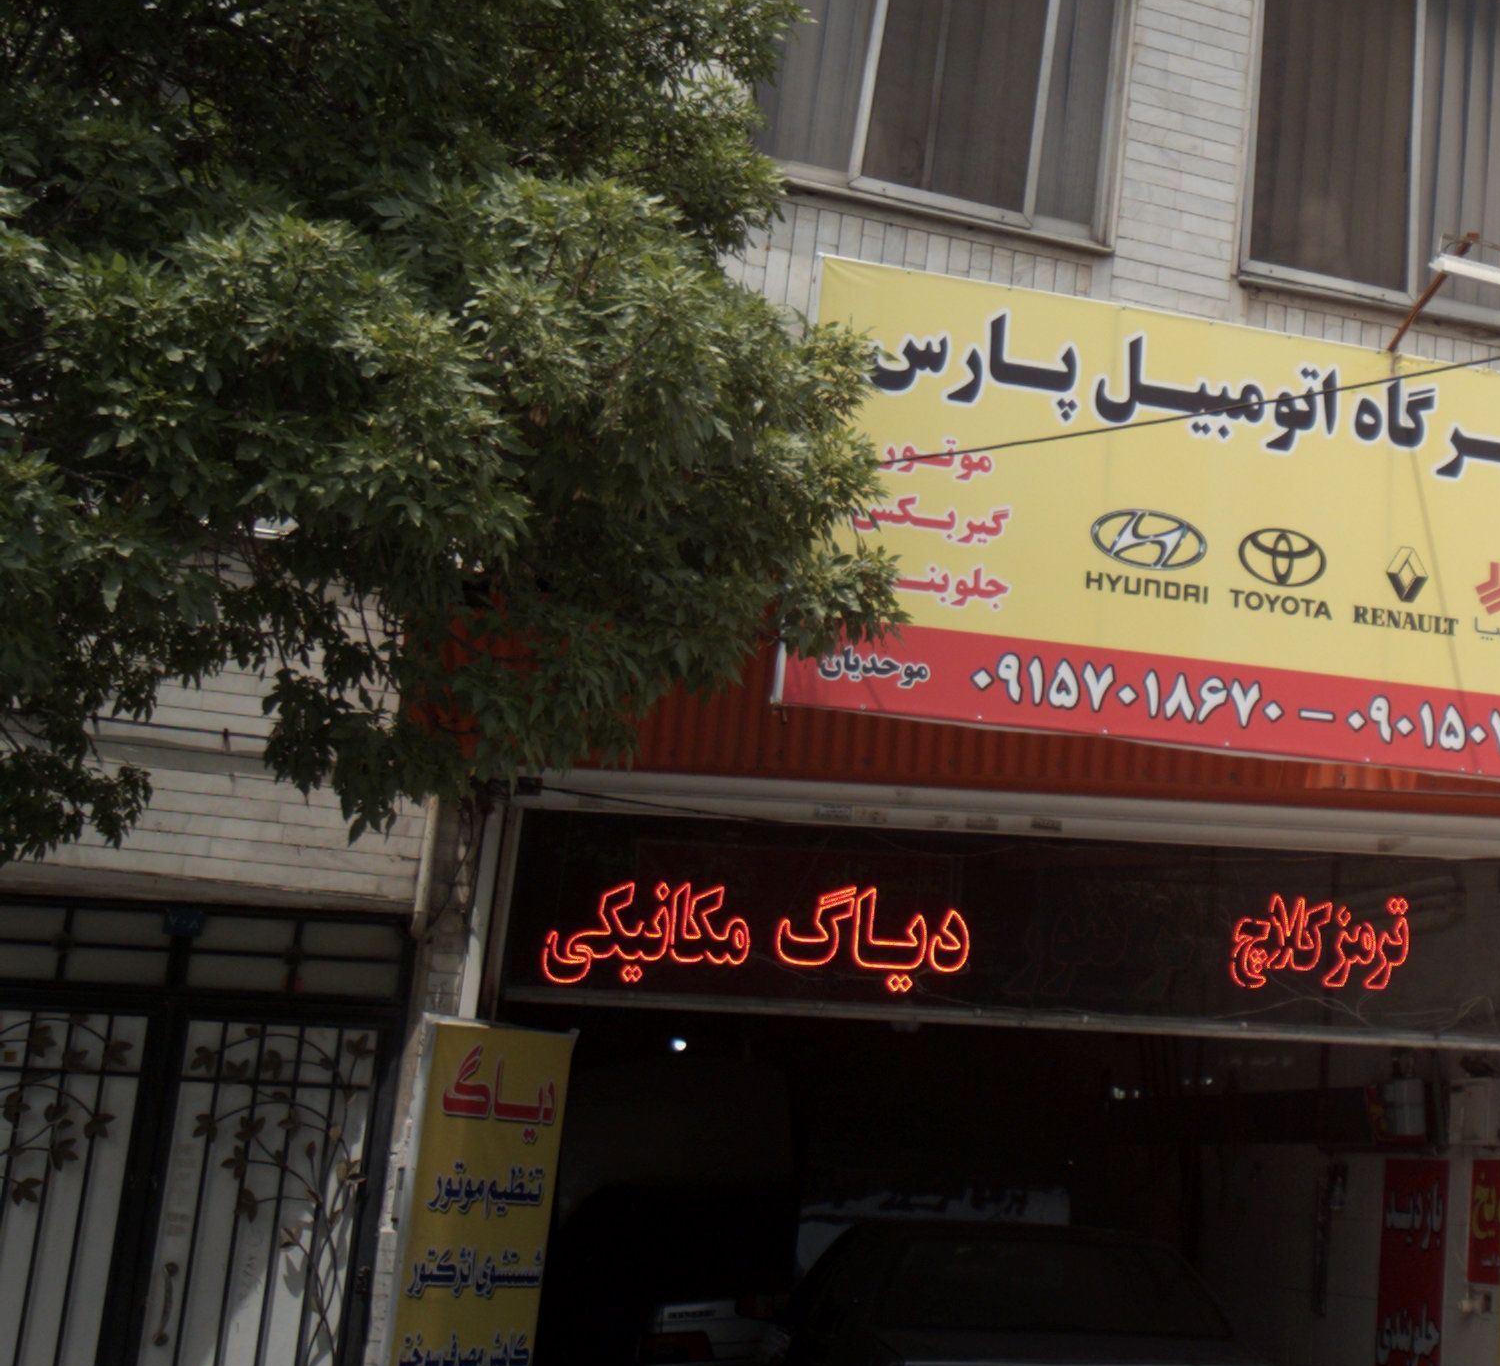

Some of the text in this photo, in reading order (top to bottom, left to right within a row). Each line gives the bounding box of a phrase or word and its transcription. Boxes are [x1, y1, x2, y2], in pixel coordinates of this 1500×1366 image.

[867, 313, 1078, 422] پارس
[1095, 335, 1338, 452] اتومبیل
[879, 438, 993, 481] موتور
[1085, 570, 1209, 605] HYUNDAI
[1229, 588, 1333, 621] TOYOTA
[1352, 604, 1459, 636] RENAULT
[818, 647, 930, 688] موحدیان
[541, 881, 751, 985] مکانیکی
[776, 885, 970, 993] دیاگ
[1230, 892, 1334, 990] کلاچ
[1322, 897, 1410, 990] ترمز
[441, 1043, 557, 1143] دیاگ
[428, 1162, 545, 1218] تنظیم موتور
